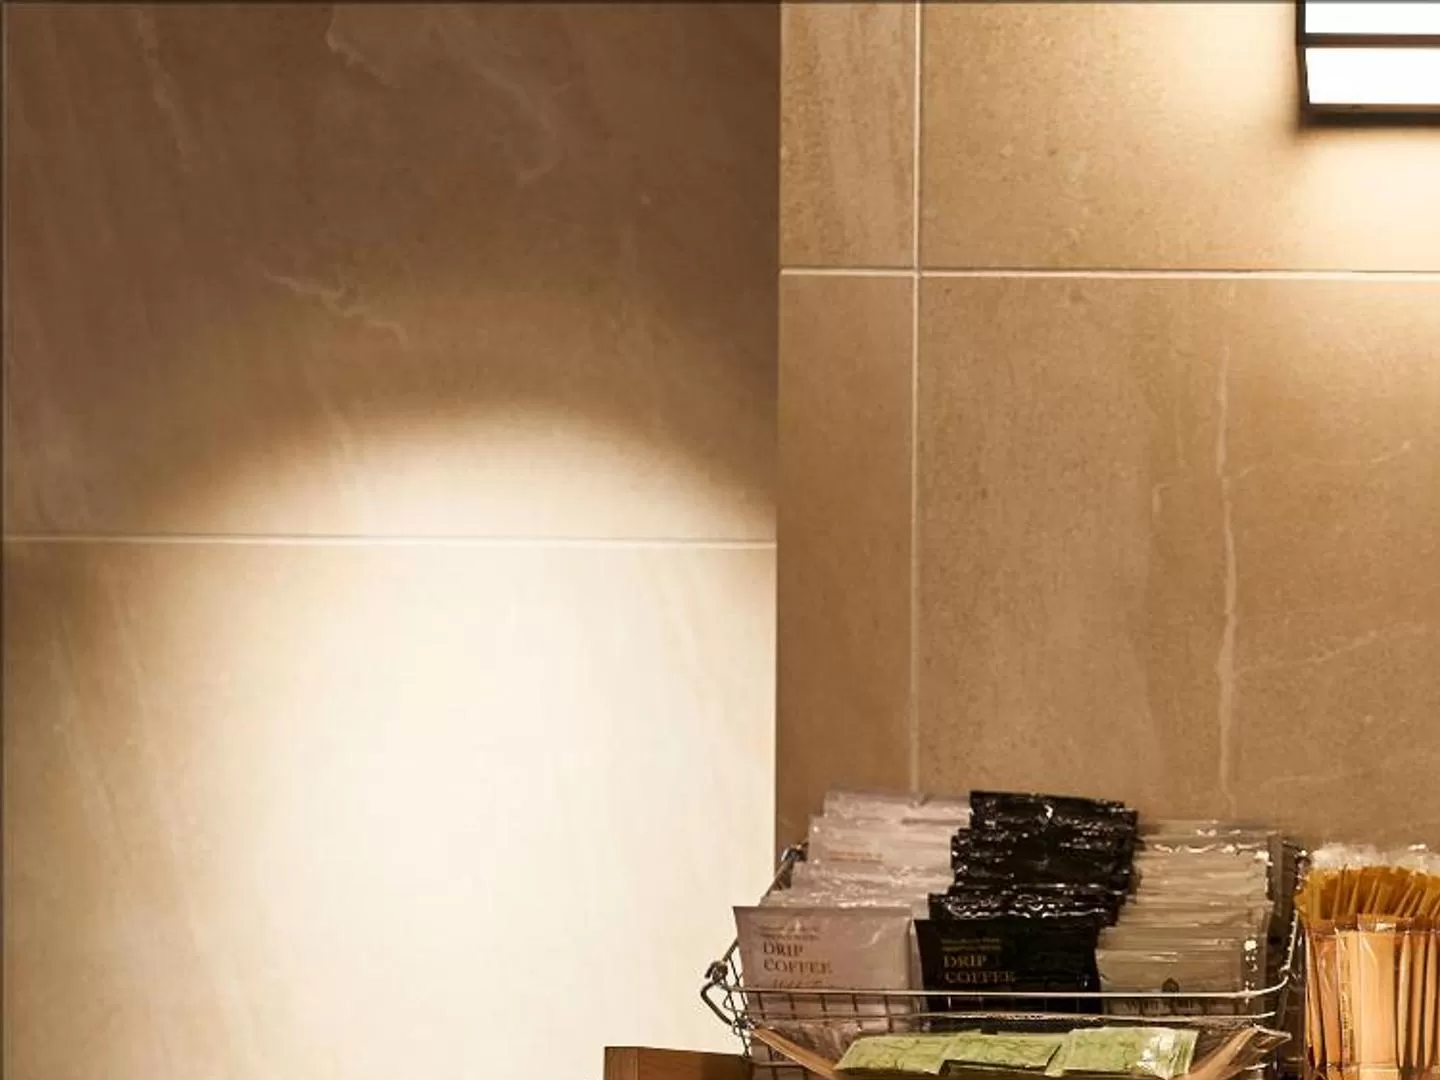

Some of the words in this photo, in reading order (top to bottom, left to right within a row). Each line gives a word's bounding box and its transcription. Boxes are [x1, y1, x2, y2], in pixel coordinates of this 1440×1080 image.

[763, 941, 804, 957] DRIP
[763, 959, 833, 974] COFFEE
[943, 954, 988, 969] DRIP
[944, 970, 1016, 985] COFFEE
